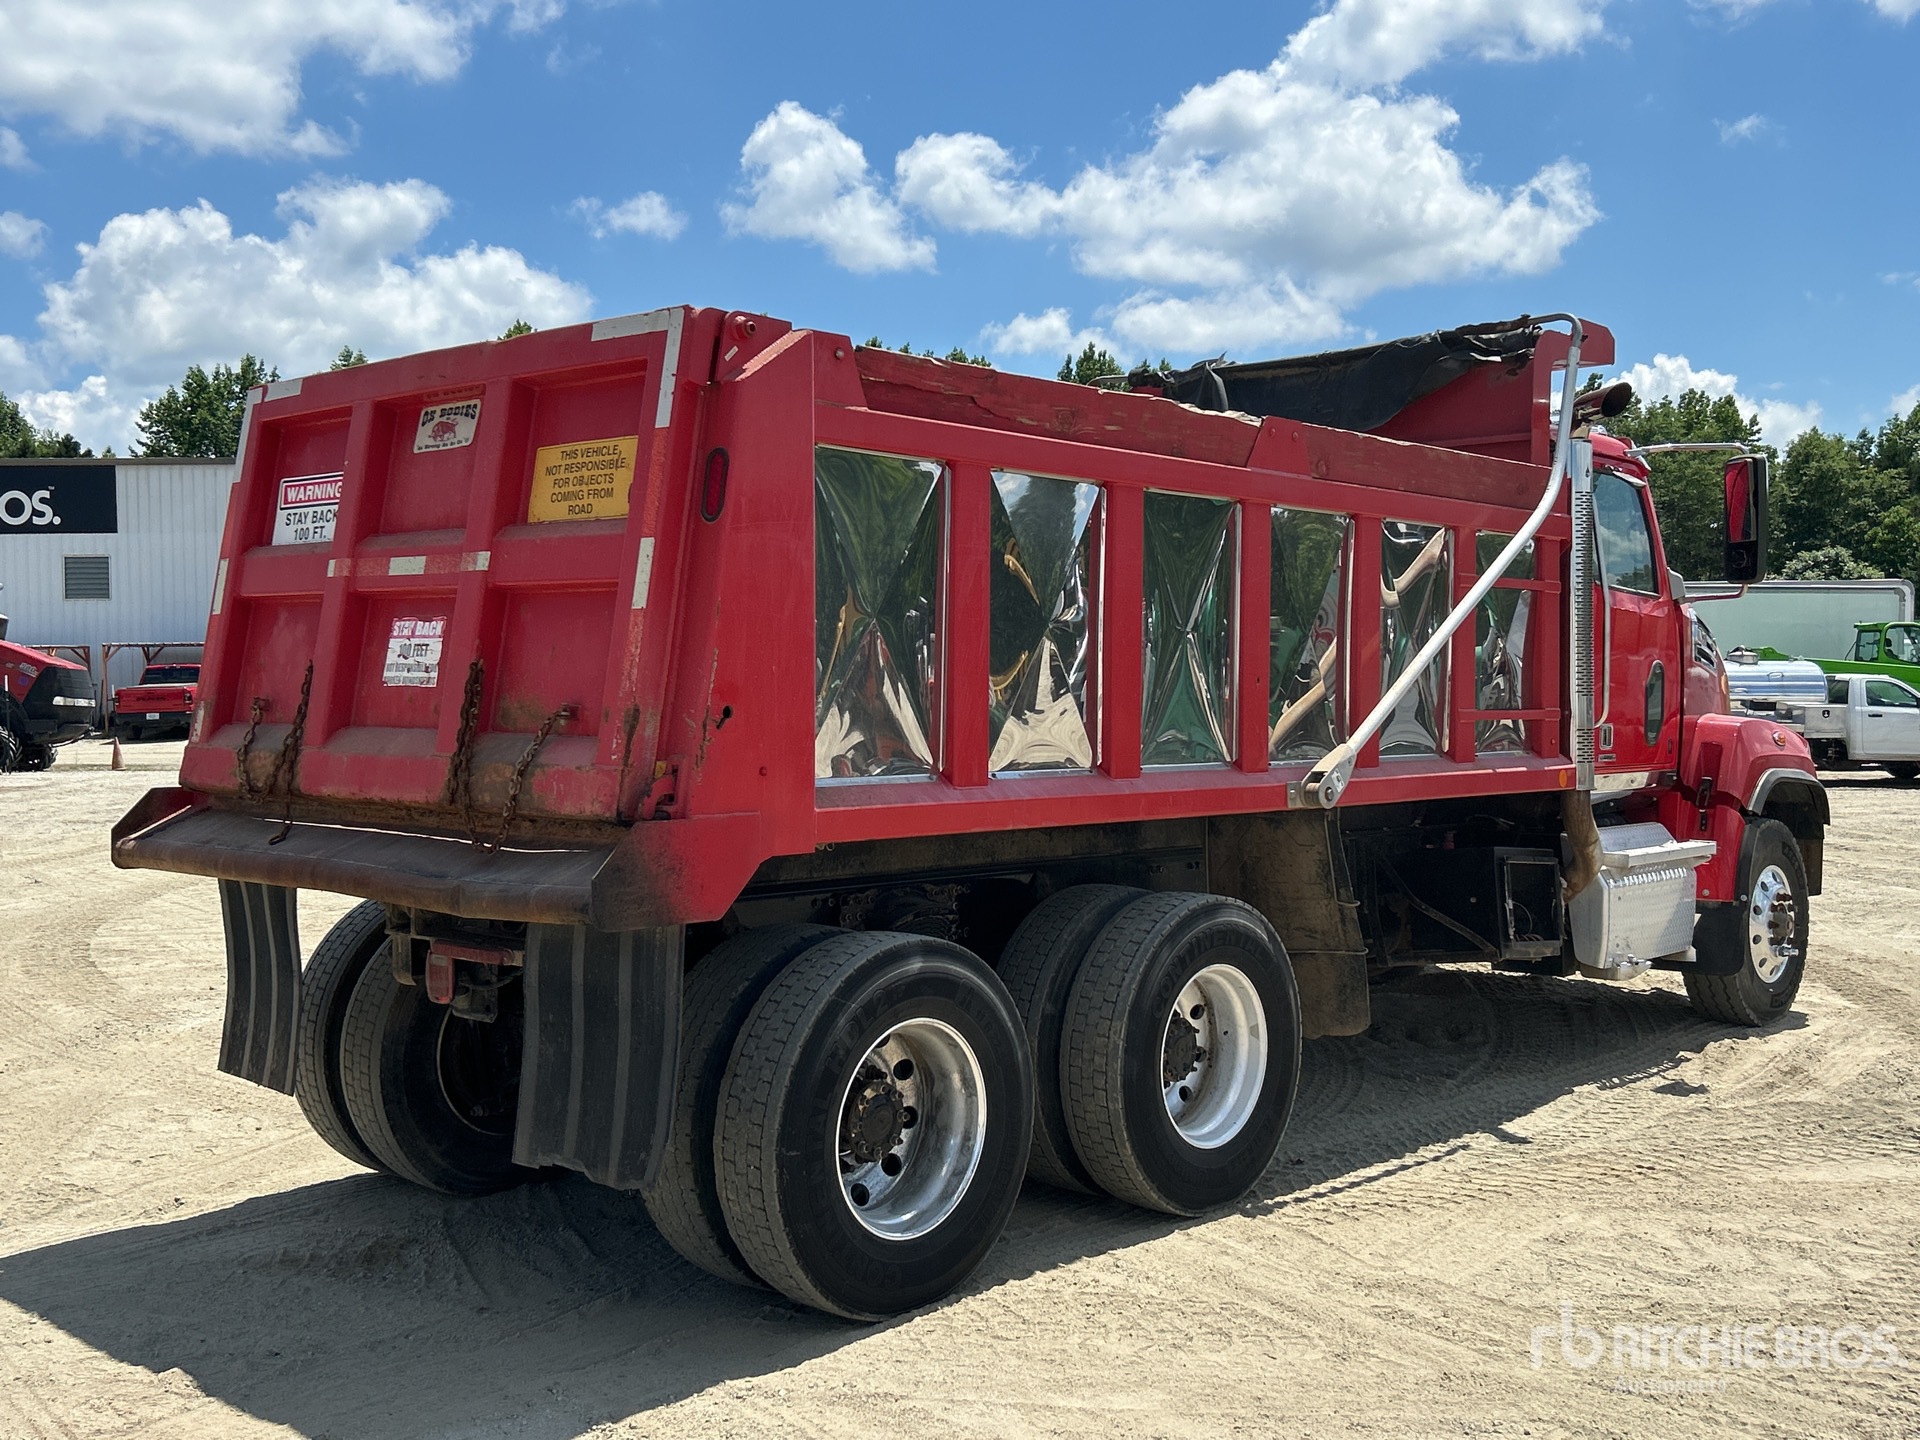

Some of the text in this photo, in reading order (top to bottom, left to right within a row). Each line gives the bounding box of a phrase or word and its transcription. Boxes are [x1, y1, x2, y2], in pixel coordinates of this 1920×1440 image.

[439, 403, 478, 420] BODIES
[560, 444, 619, 462] THIS VEHICLE
[545, 457, 627, 477] NOT RESPONSIBLE
[552, 473, 615, 489] FOR OBJECTS
[286, 481, 343, 503] WARNING
[550, 487, 614, 504] COMING FROM
[567, 503, 594, 516] ROAD
[285, 511, 309, 527] STAY
[294, 525, 326, 541] 100 FT.
[393, 620, 444, 636] STAY BACK
[412, 642, 430, 658] FEET
